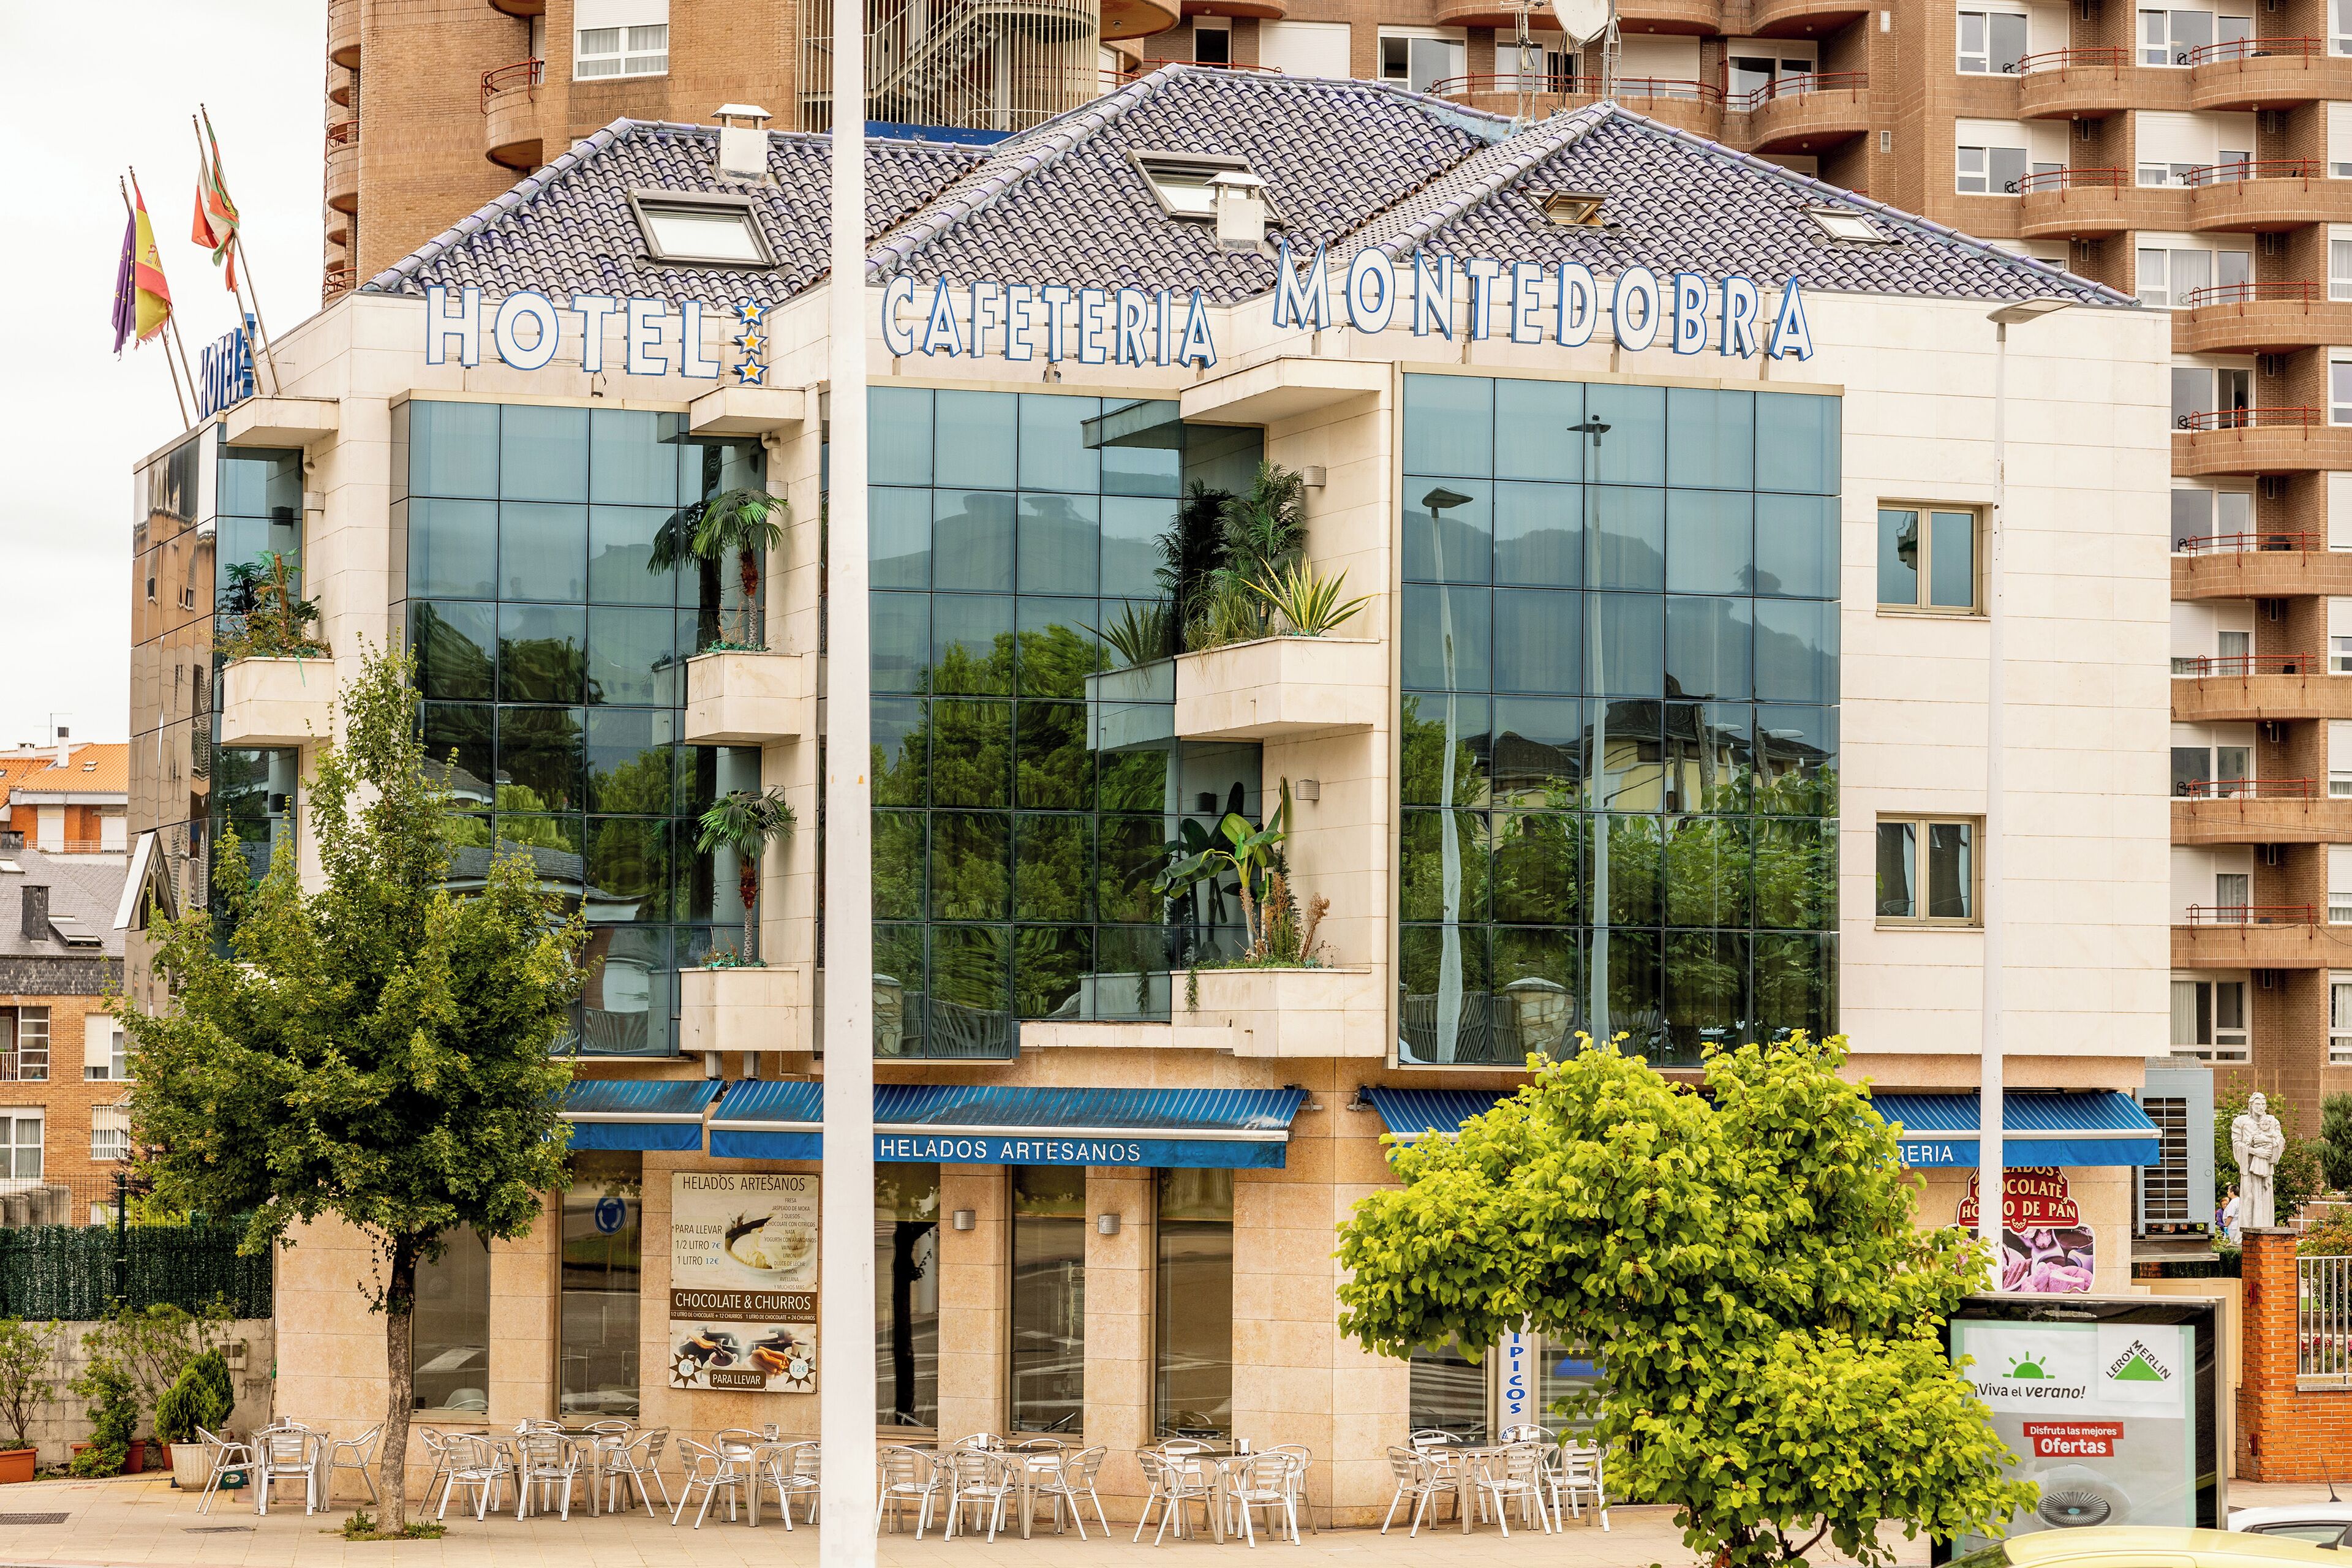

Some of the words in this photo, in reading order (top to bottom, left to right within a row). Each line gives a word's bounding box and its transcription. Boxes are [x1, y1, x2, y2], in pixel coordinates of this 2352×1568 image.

[1272, 238, 1813, 362] MONTEDOBRA
[882, 274, 1217, 369] CAFETERIA
[426, 285, 721, 379] HOTEL
[200, 327, 243, 422] HOTEL
[881, 1139, 987, 1159] HELADOS
[1000, 1141, 1141, 1161] ARTESANOS
[1883, 1145, 1954, 1162] RERIA
[683, 1176, 734, 1190] HELADOS
[741, 1177, 805, 1191] ARTESANOS
[1962, 1200, 2015, 1218] HOO
[2022, 1200, 2041, 1216] DE
[2048, 1202, 2076, 1219] PAN
[675, 1224, 694, 1234] PARA
[696, 1224, 722, 1234] LLEVAR
[676, 1240, 687, 1249] 1/2
[689, 1240, 709, 1250] LITRO
[677, 1256, 680, 1265] 1
[683, 1256, 703, 1265] LITRO
[676, 1292, 741, 1308] CHOCOLATE
[744, 1295, 752, 1309] &
[755, 1295, 811, 1310] CHURROS
[2105, 1346, 2135, 1379] LEROY
[2132, 1340, 2171, 1379] MERLIN
[712, 1374, 732, 1384] PARA
[734, 1374, 761, 1385] LLEVAR
[1506, 1332, 1526, 1415] IPICOS
[1974, 1383, 2008, 1398] ¡Viva
[2011, 1387, 2022, 1396] el
[2026, 1385, 2086, 1399] verano!
[2030, 1426, 2066, 1435] Disfruta
[2067, 1426, 2081, 1435] las
[2082, 1427, 2117, 1437] mejores
[2041, 1437, 2106, 1454] Ofertas
